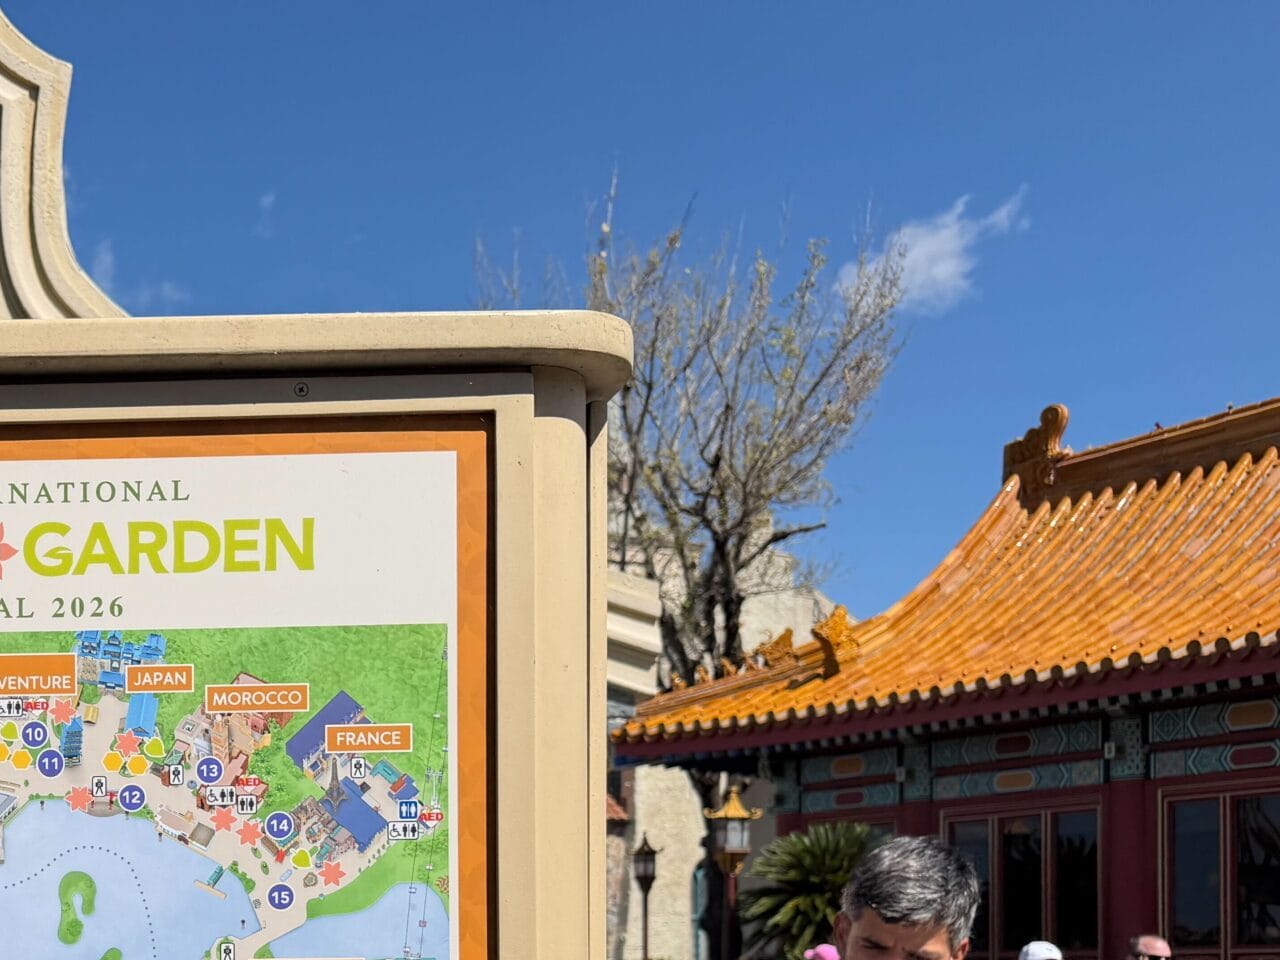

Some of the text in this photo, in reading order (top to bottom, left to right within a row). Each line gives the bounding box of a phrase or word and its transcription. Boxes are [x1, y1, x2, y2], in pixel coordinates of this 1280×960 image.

[23, 517, 315, 577] GARDEN
[51, 596, 124, 618] 2026
[133, 671, 187, 686] JAPAN
[212, 690, 303, 706] MOROCCO
[25, 702, 49, 710] AED
[25, 727, 44, 742] 10
[336, 730, 401, 746] FRANCE
[41, 757, 59, 770] 11
[199, 764, 219, 777] 13
[237, 778, 261, 787] AED
[122, 790, 141, 804] 12
[420, 813, 443, 821] AED
[270, 818, 289, 832] 14
[271, 891, 290, 904] 15
